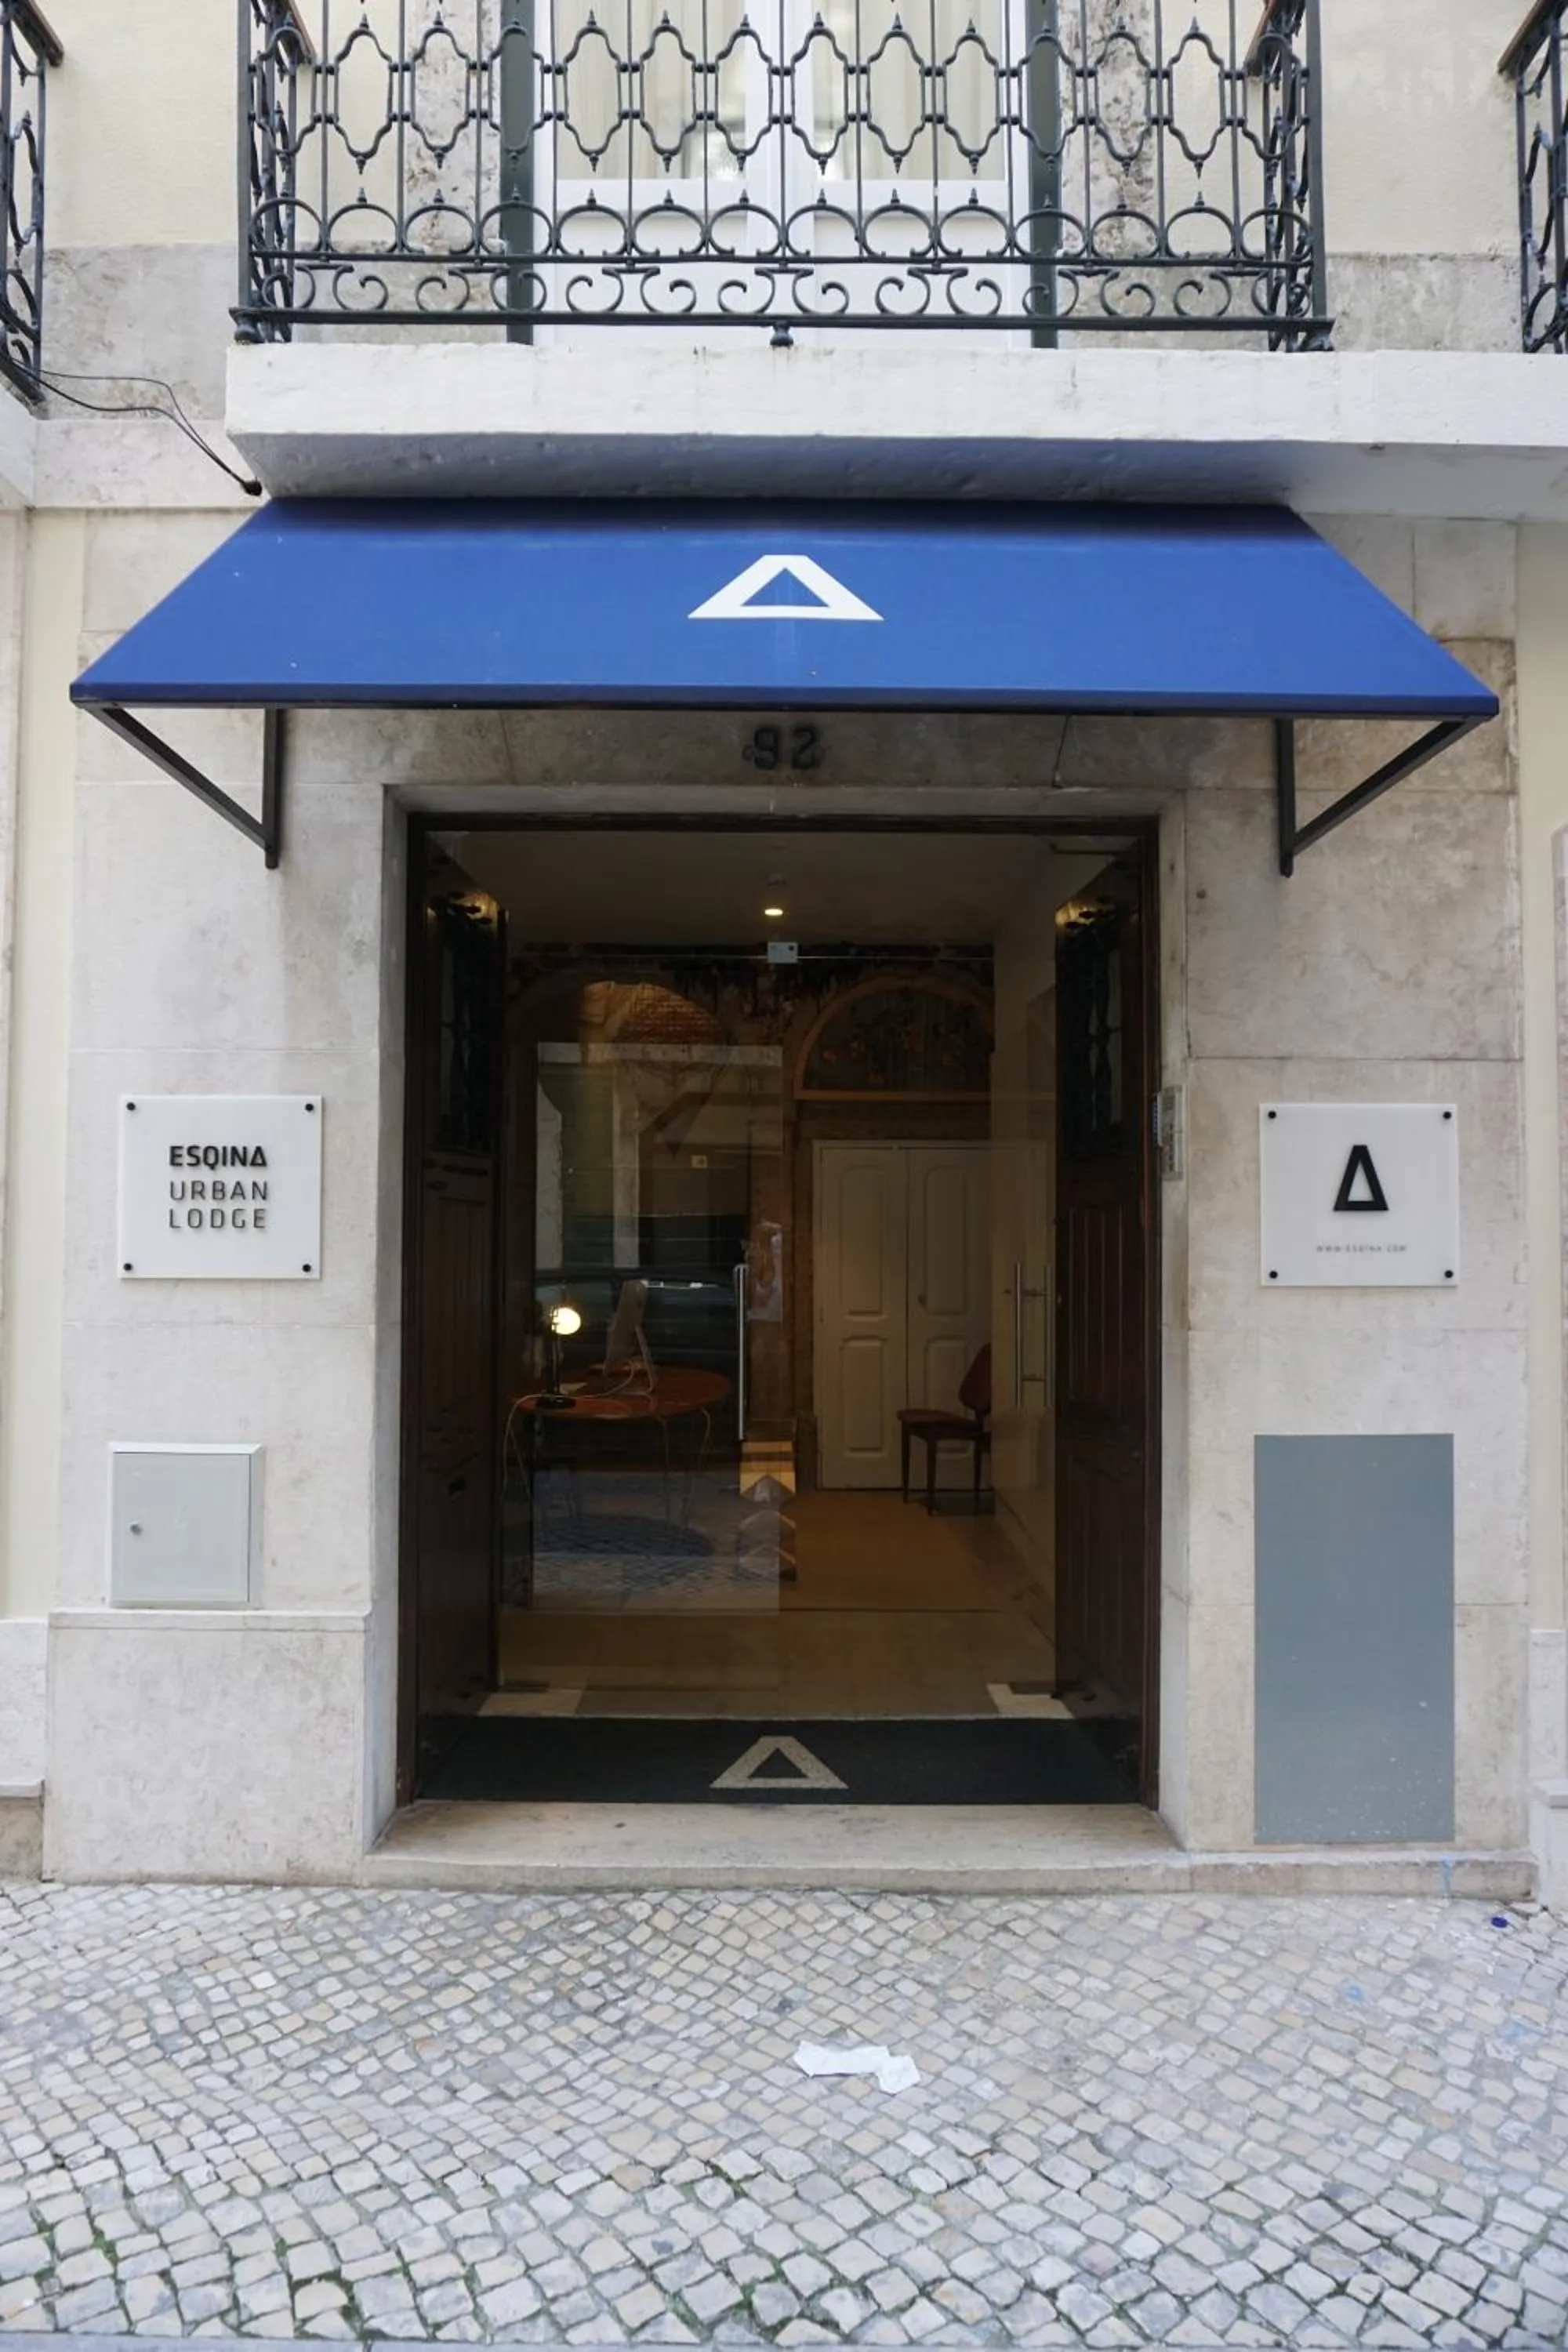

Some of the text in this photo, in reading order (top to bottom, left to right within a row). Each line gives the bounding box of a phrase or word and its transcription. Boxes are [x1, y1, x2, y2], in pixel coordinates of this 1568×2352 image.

[752, 726, 819, 771] 92
[169, 1180, 267, 1201] URBAN
[169, 1208, 267, 1229] LODGE
